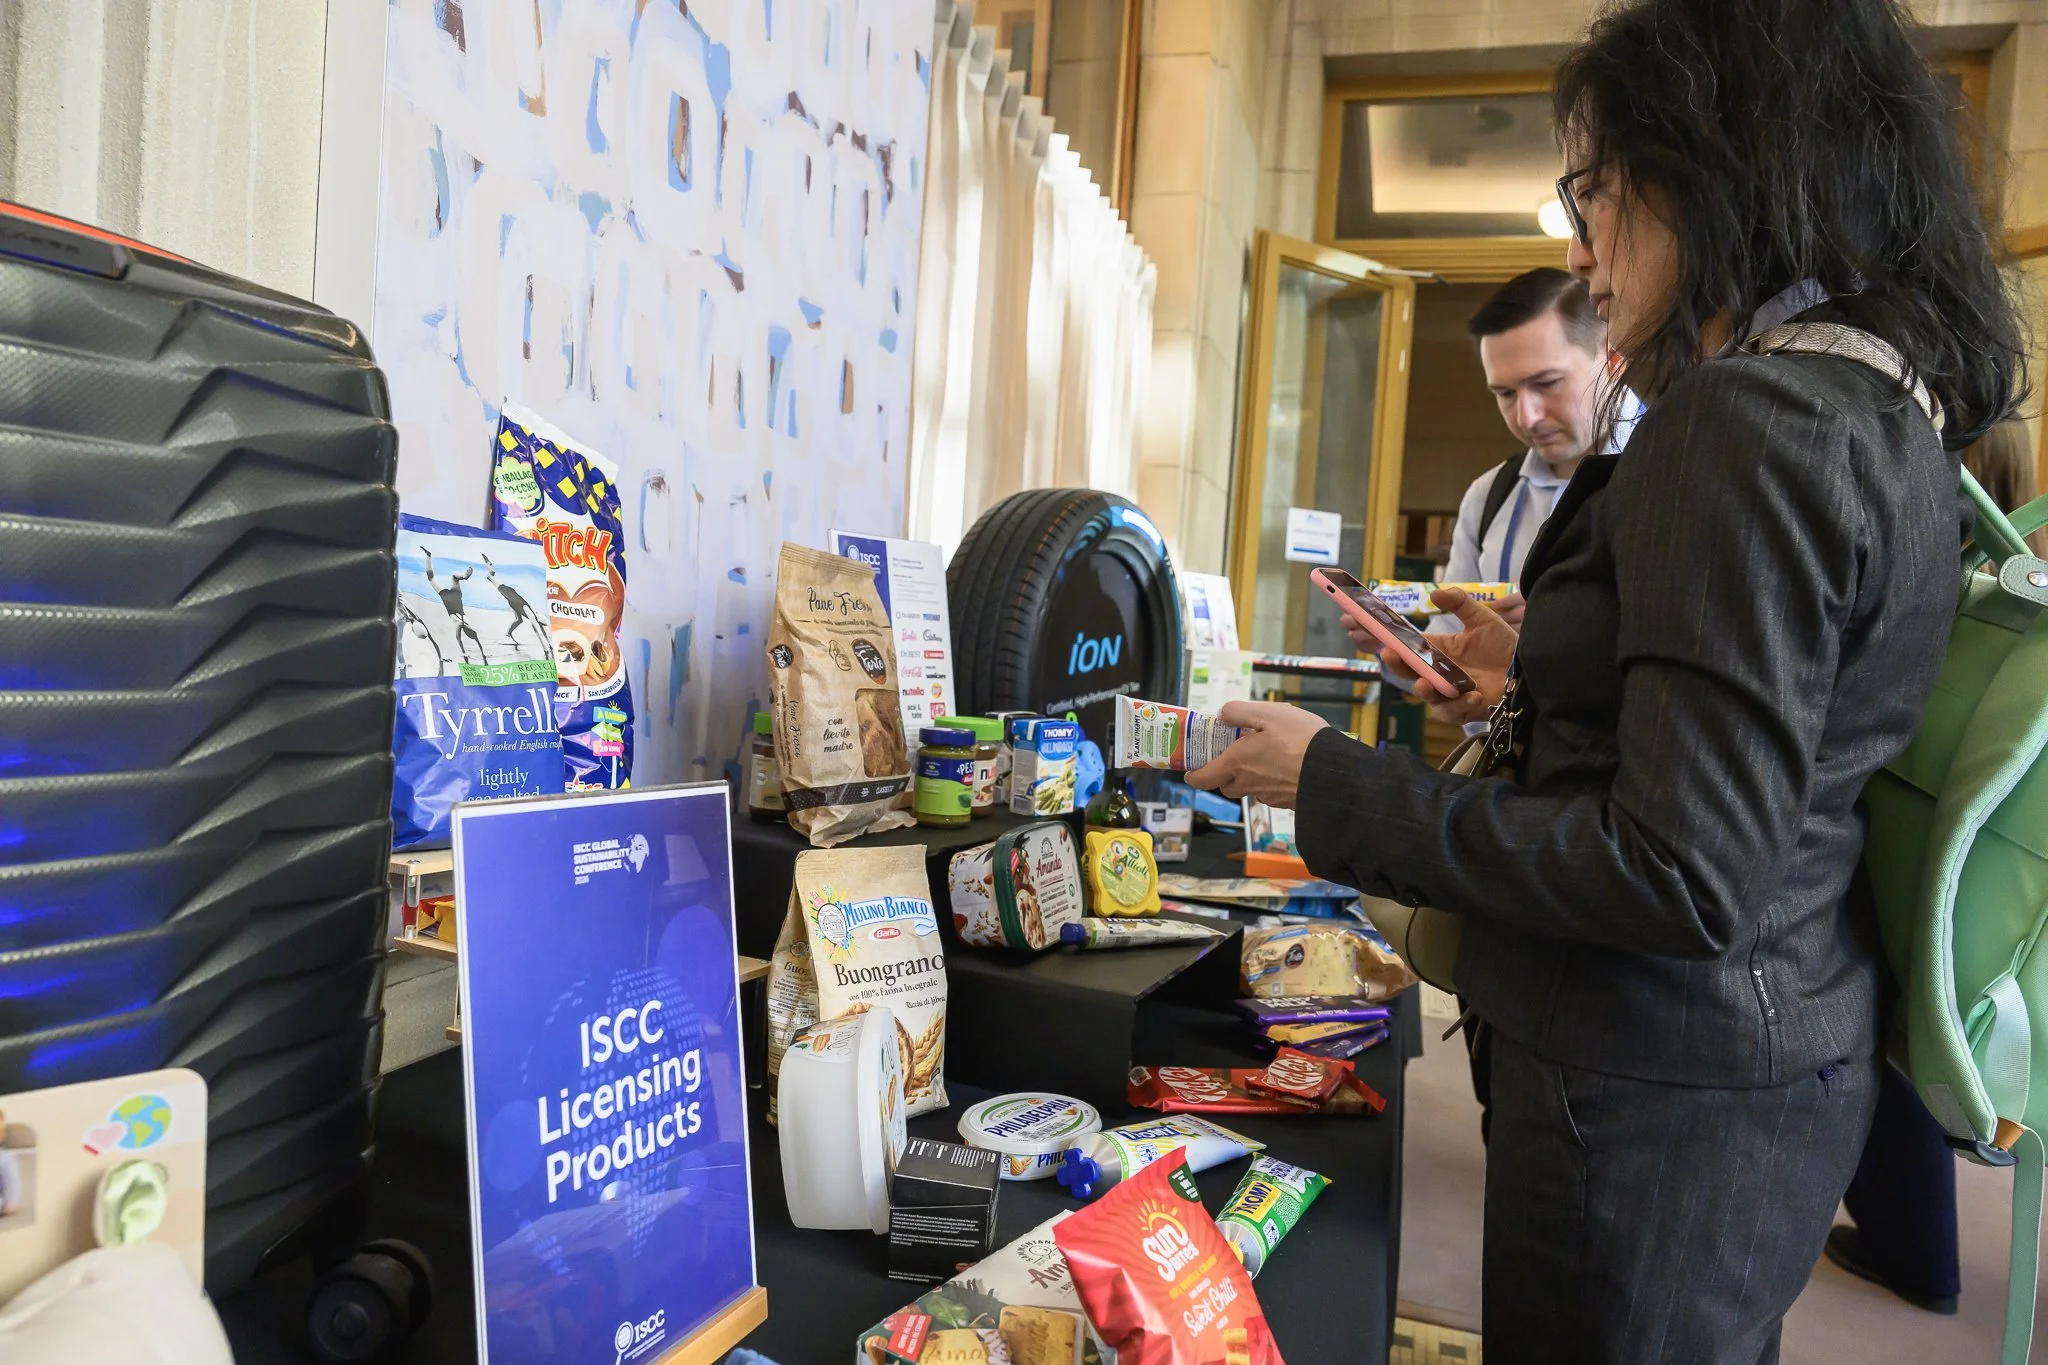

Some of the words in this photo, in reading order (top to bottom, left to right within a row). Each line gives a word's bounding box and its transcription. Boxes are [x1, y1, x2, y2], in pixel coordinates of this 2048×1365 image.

[860, 552, 880, 565] ISCC
[807, 587, 834, 612] Pane
[551, 603, 596, 619] CHOCOLAT
[480, 665, 519, 684] 25%
[902, 687, 924, 696] nutella
[828, 717, 843, 725] con
[823, 727, 851, 741] lievito
[1044, 728, 1074, 738] THOMY
[462, 741, 517, 753] hand-cooked
[519, 740, 547, 752] English
[824, 742, 853, 753] madre
[479, 767, 529, 791] lightly
[573, 843, 591, 854] ISCC
[591, 839, 620, 851] GLOBAL
[574, 848, 632, 865] SUSTAINABILITY
[574, 859, 622, 875] CONFERENCE
[844, 902, 885, 927] MULINO
[884, 896, 928, 918] BIANCO
[834, 954, 945, 987] Buongrano
[861, 988, 879, 998] 100%
[880, 986, 903, 996] Farina
[580, 1000, 664, 1068] ISCC
[538, 1049, 701, 1145] Licensing
[983, 1099, 1077, 1137] PHILADELPHIA
[546, 1101, 701, 1204] Products
[1234, 1182, 1272, 1214] THOMY
[1209, 1276, 1238, 1312] Chilli
[634, 1309, 665, 1343] ISCC
